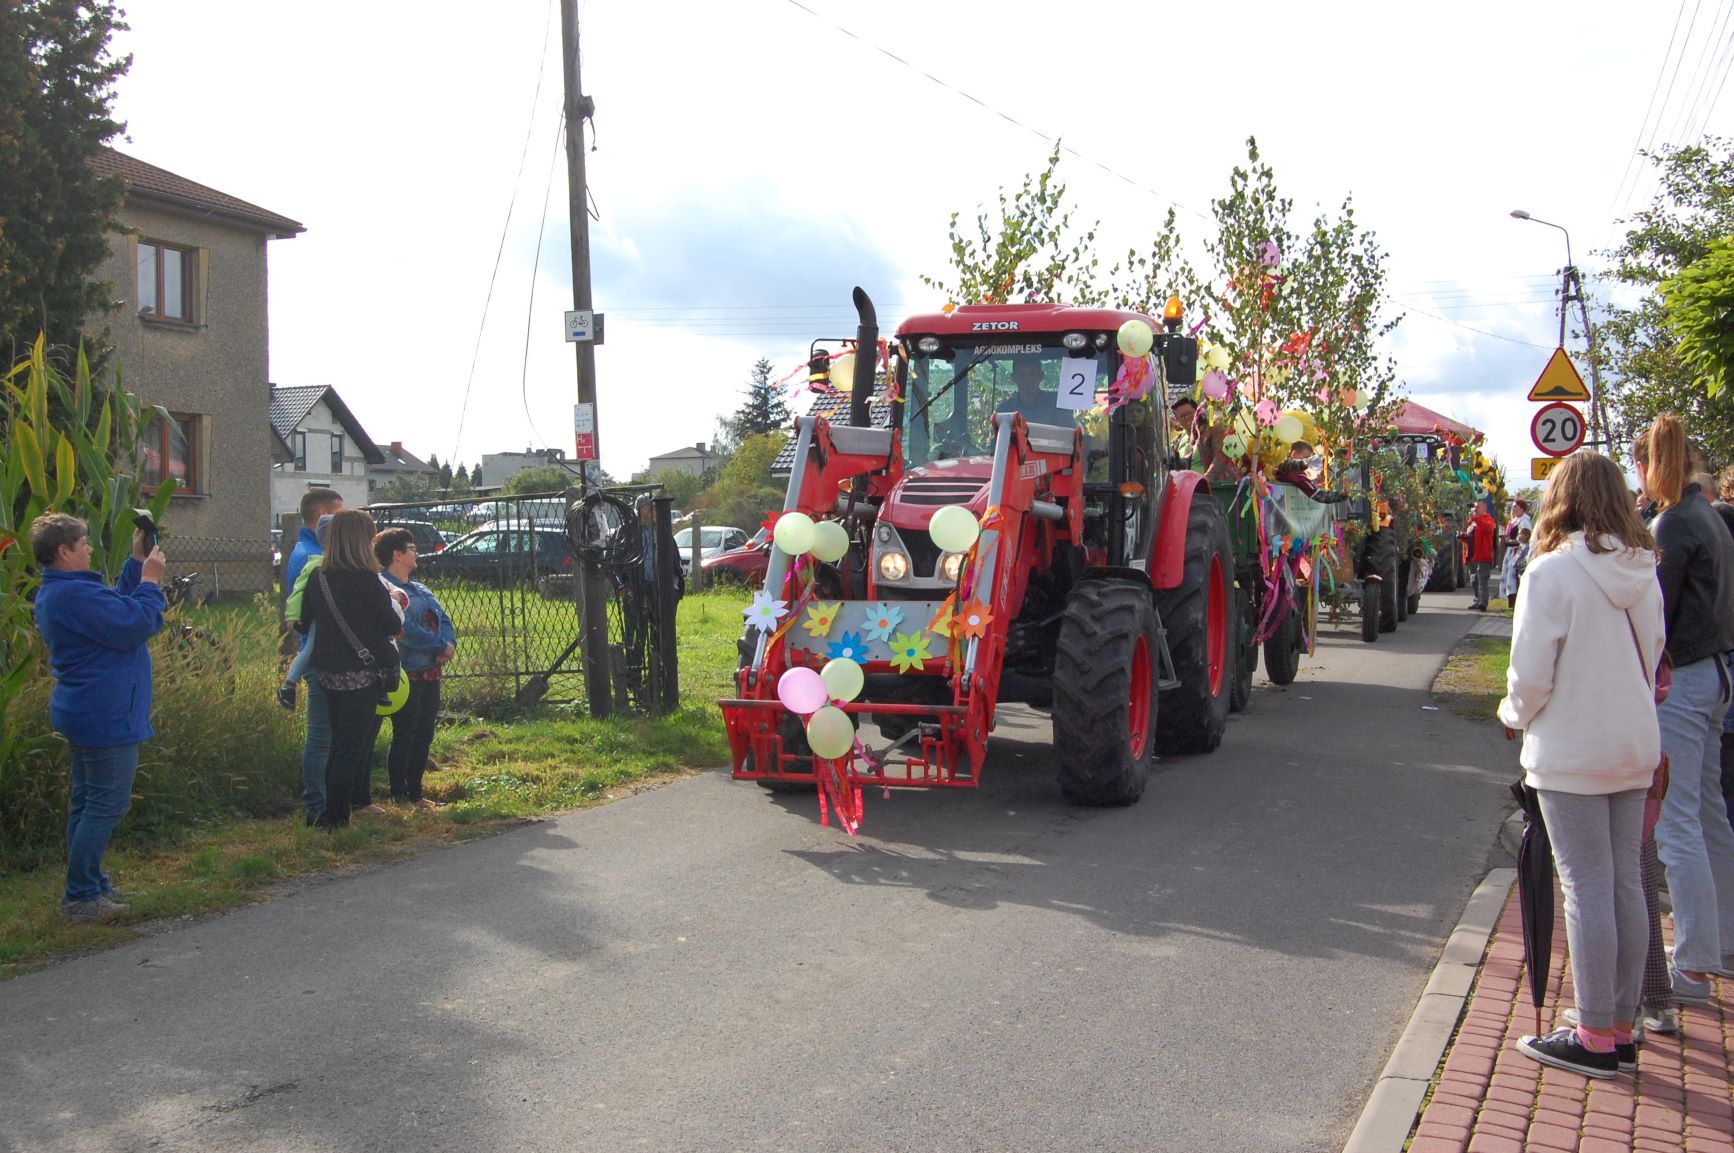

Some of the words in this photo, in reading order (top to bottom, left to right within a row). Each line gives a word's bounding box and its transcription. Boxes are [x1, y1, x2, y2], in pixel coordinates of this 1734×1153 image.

[972, 321, 1019, 331] ZETOR
[1068, 373, 1087, 396] 2
[1541, 417, 1578, 443] 20
